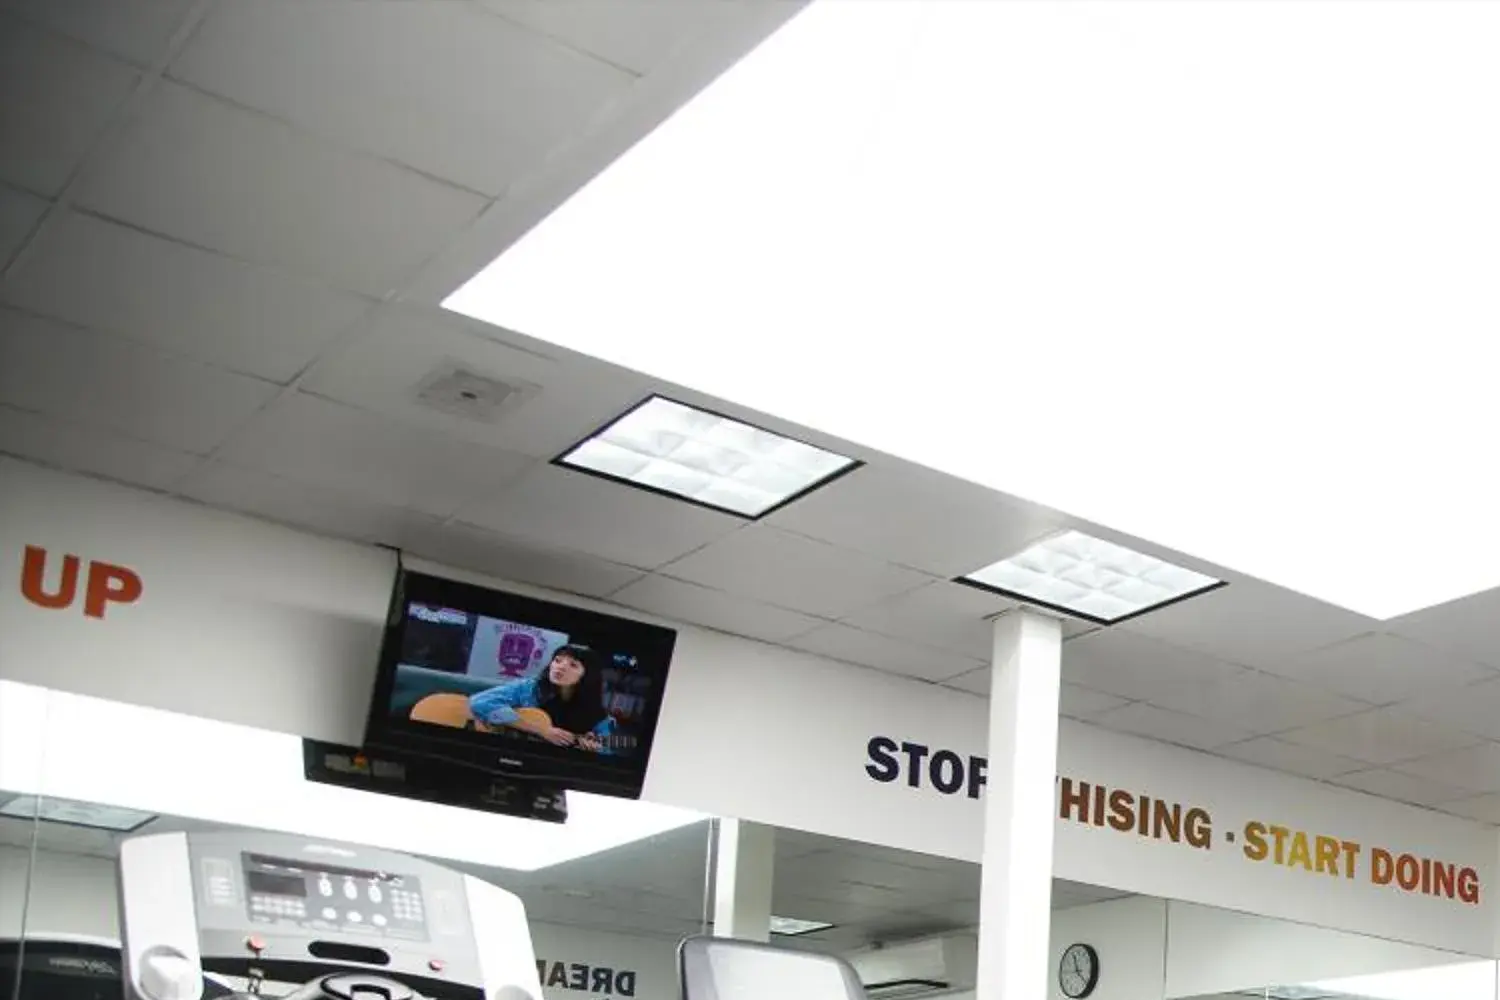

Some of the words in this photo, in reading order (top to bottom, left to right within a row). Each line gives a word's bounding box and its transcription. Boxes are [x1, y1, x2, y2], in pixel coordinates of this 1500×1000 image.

[22, 544, 143, 619] UP
[1056, 775, 1211, 849] HISING
[1243, 821, 1361, 878] START
[1371, 848, 1479, 904] DOING
